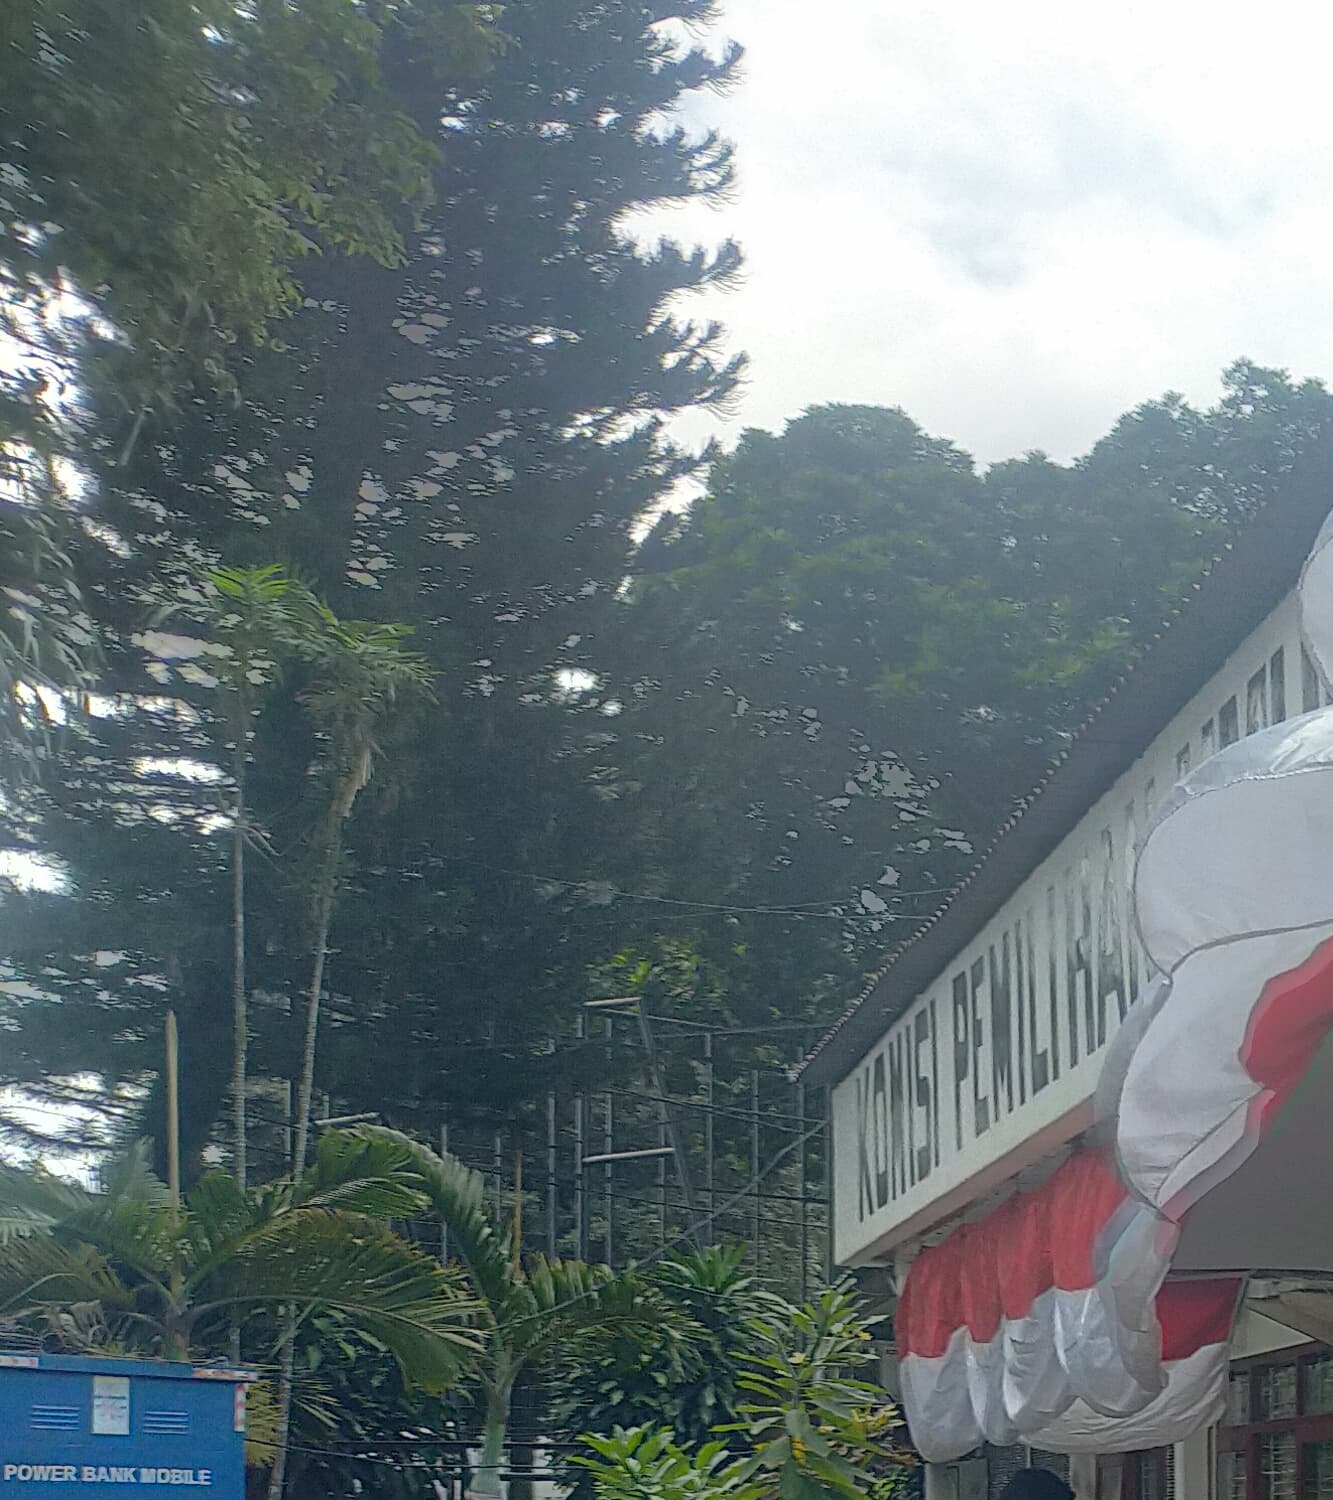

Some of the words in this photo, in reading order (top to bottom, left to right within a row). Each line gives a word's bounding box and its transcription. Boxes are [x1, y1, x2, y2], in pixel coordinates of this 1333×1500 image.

[855, 998, 940, 1223] KOMISI
[3, 1464, 77, 1482] POWER
[80, 1465, 137, 1483] BANK
[140, 1467, 214, 1486] MOBILE
